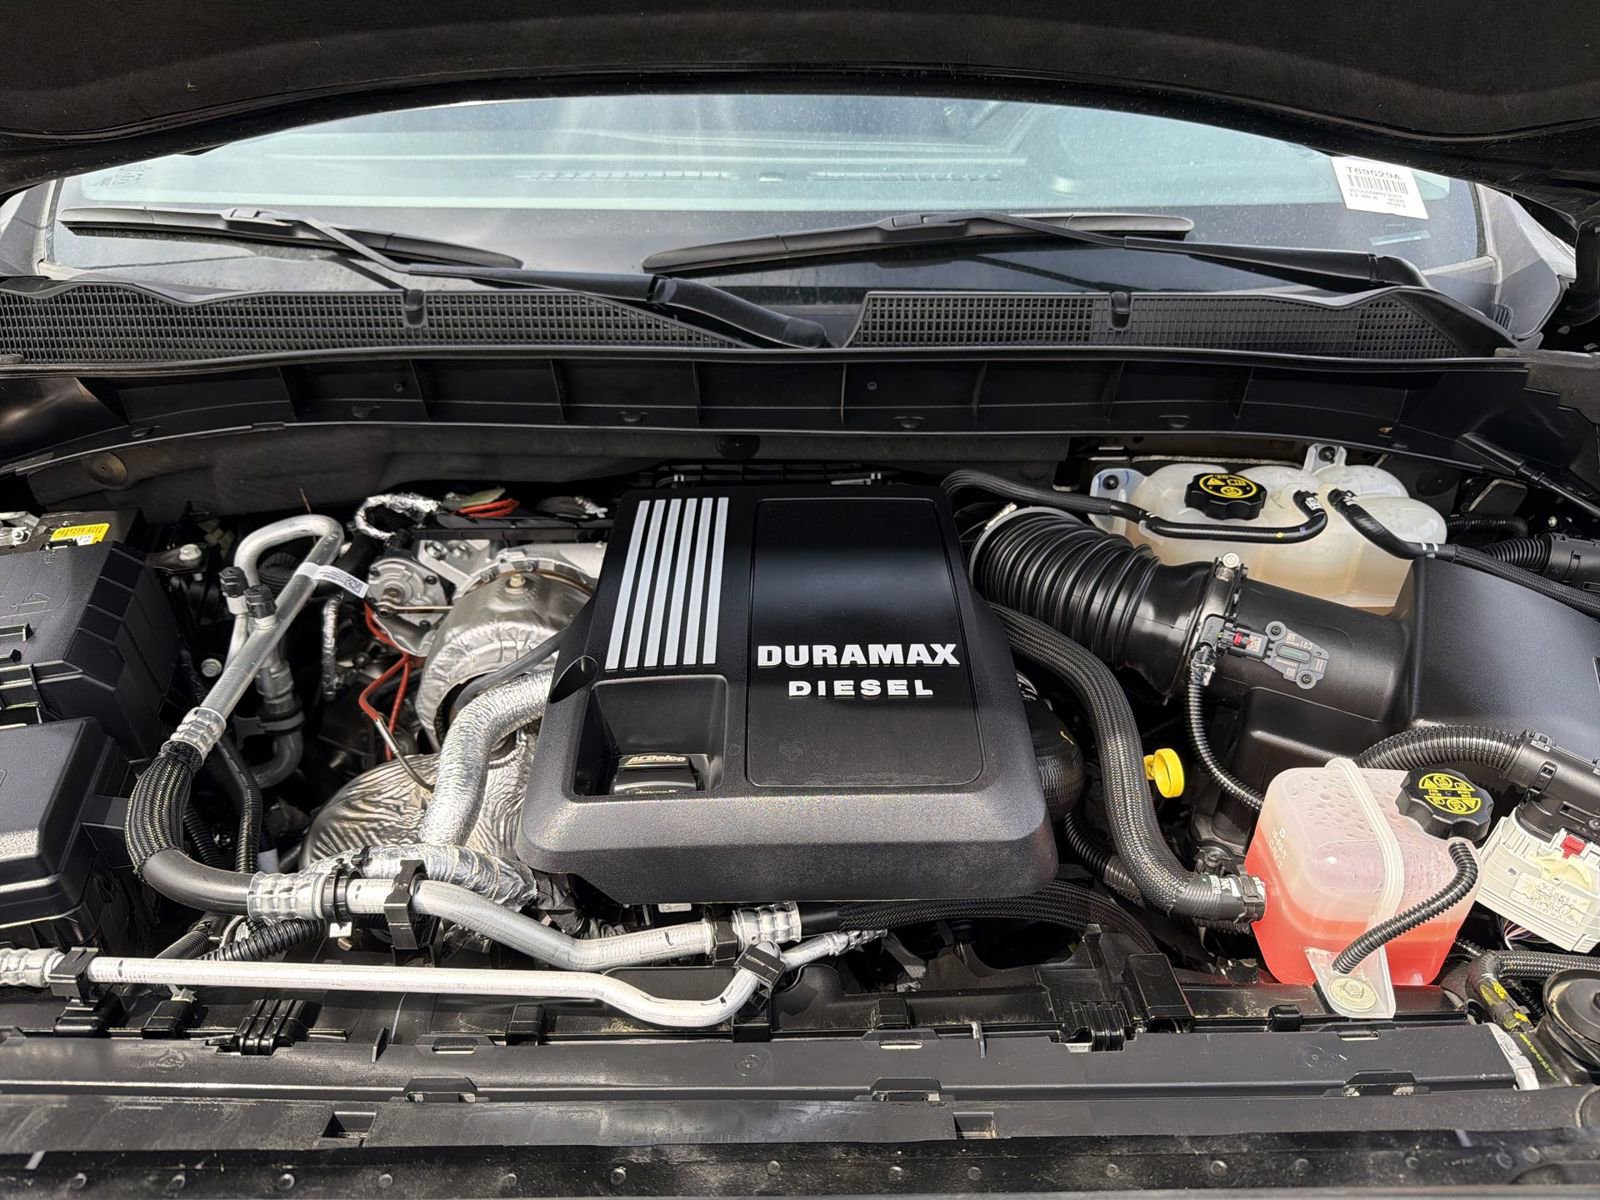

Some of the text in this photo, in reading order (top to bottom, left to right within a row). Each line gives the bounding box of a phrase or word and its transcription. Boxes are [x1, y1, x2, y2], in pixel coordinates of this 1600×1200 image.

[757, 643, 960, 667] DURAMAX
[788, 679, 934, 697] DIESEL
[624, 755, 686, 765] ACDelco
